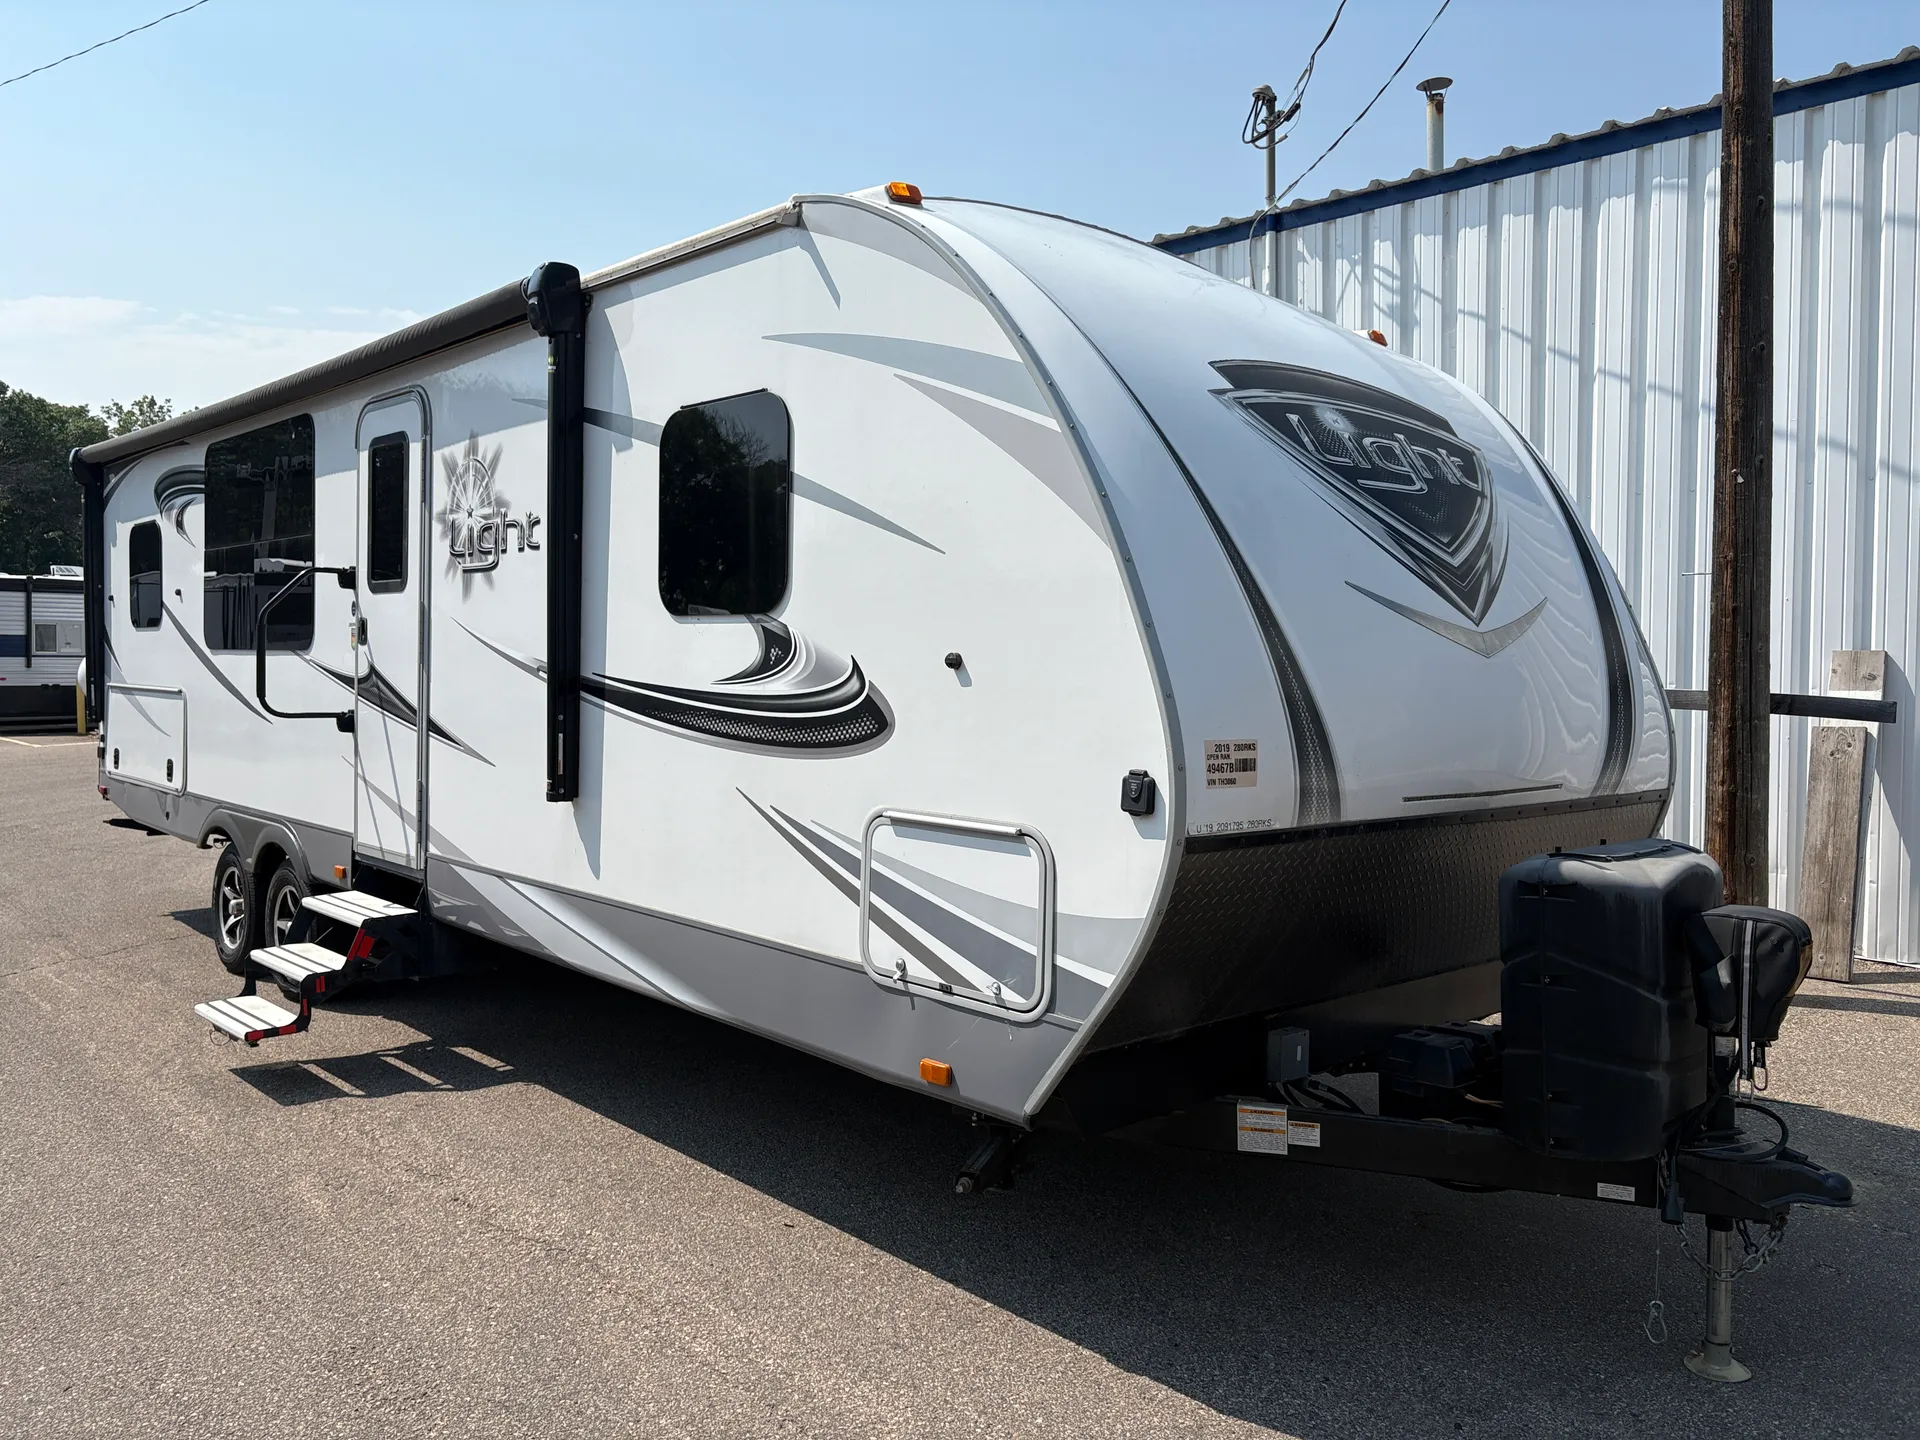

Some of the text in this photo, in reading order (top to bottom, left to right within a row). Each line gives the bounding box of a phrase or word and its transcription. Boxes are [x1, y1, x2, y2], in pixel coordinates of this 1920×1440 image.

[1285, 411, 1481, 494] Light
[448, 507, 541, 573] Light
[1214, 743, 1256, 753] 2019 280RKS
[1207, 763, 1234, 774] 49467B
[1207, 778, 1217, 786] VIN
